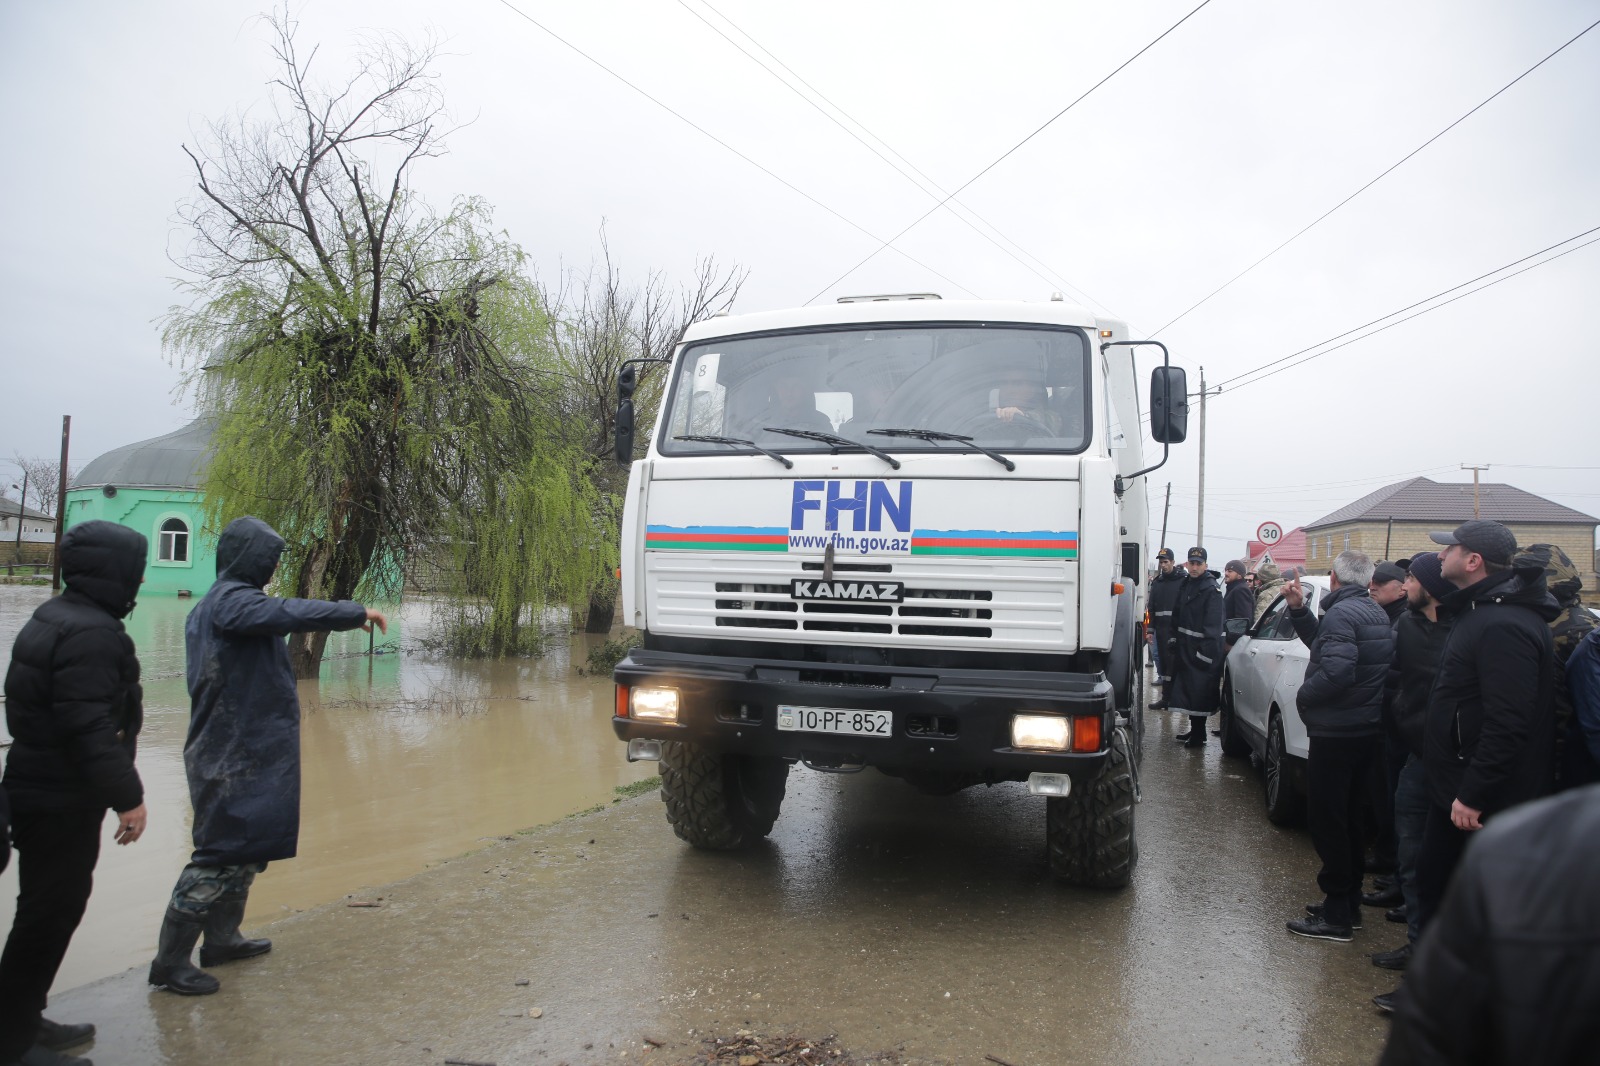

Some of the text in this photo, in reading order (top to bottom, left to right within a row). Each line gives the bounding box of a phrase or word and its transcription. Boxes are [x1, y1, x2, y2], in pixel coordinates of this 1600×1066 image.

[698, 364, 706, 377] 8
[790, 480, 913, 532] FHN
[788, 532, 909, 554] wwwfhn.gov.az
[1263, 528, 1278, 539] 30
[794, 581, 899, 600] KAMAZ
[798, 710, 888, 734] 10-PF-852
